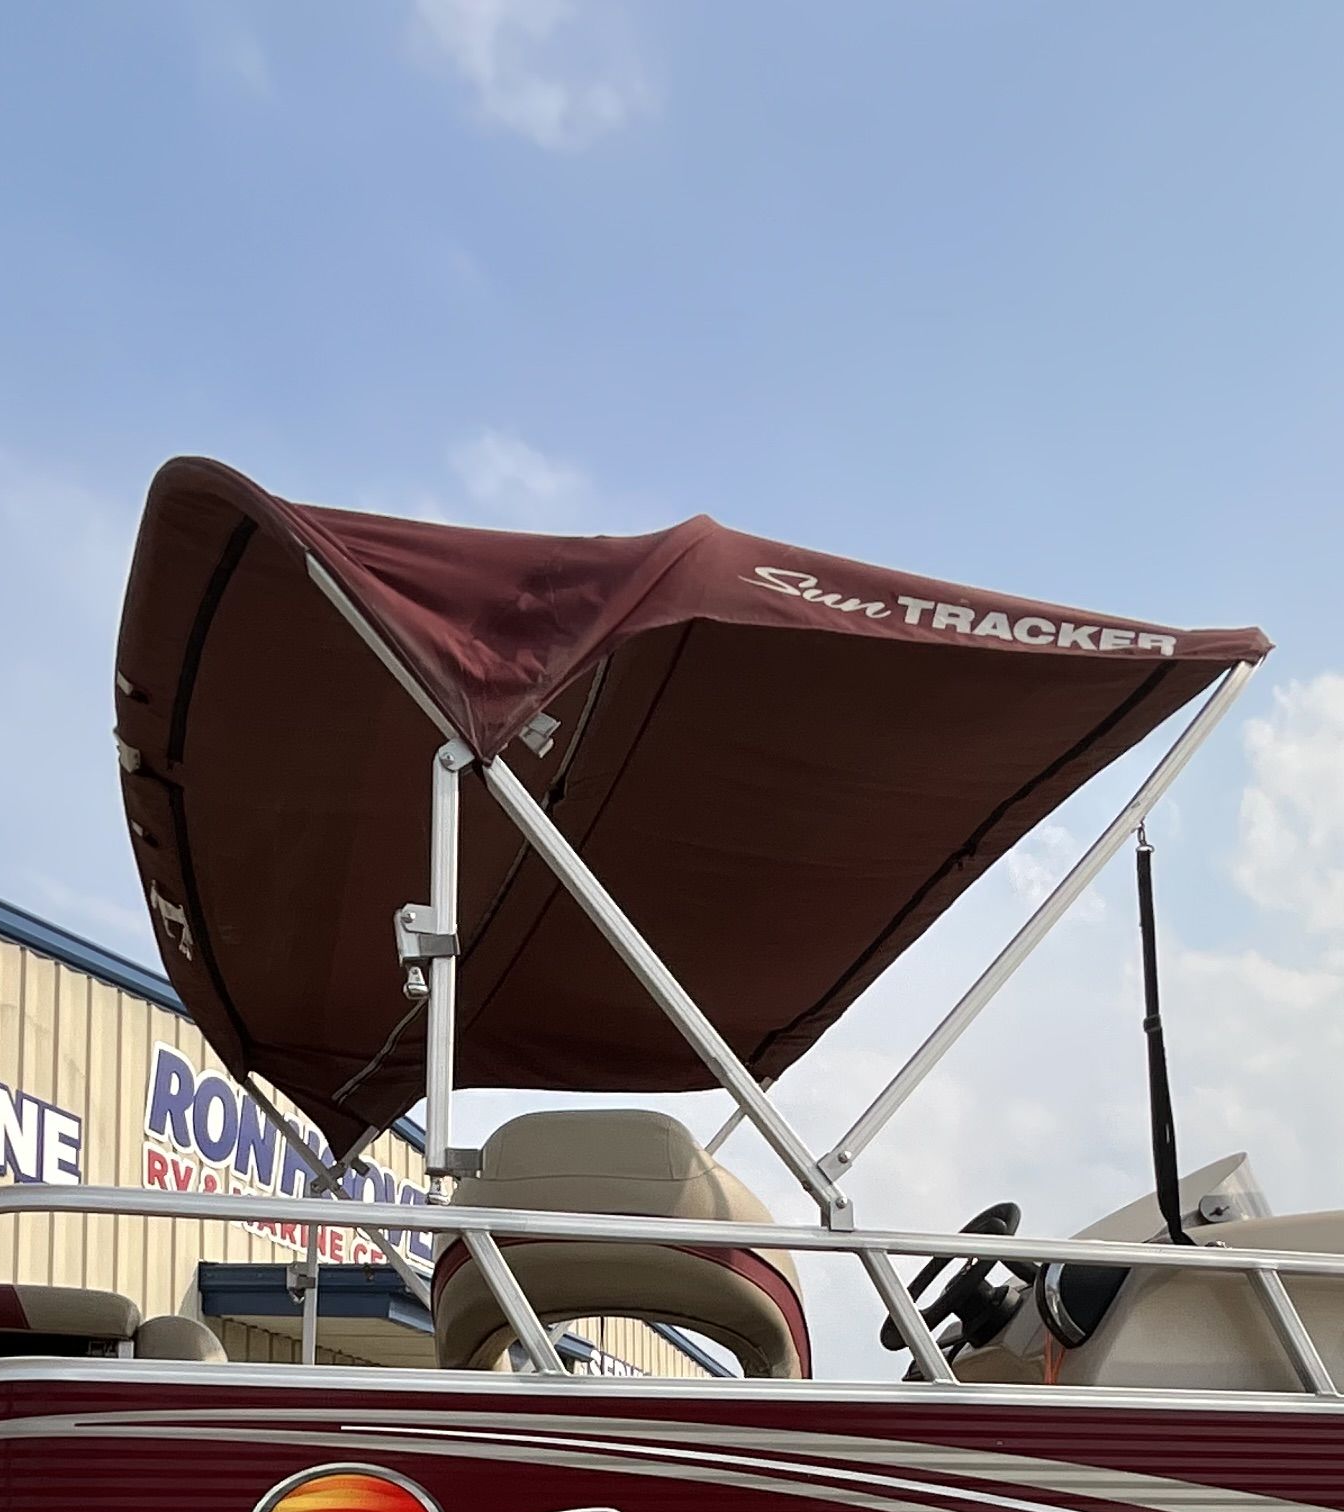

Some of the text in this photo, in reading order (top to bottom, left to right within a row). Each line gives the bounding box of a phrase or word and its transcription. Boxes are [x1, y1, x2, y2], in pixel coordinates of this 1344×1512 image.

[738, 566, 1177, 657] Sun TRACKER
[147, 1047, 277, 1188] RON
[147, 1148, 194, 1192] RV
